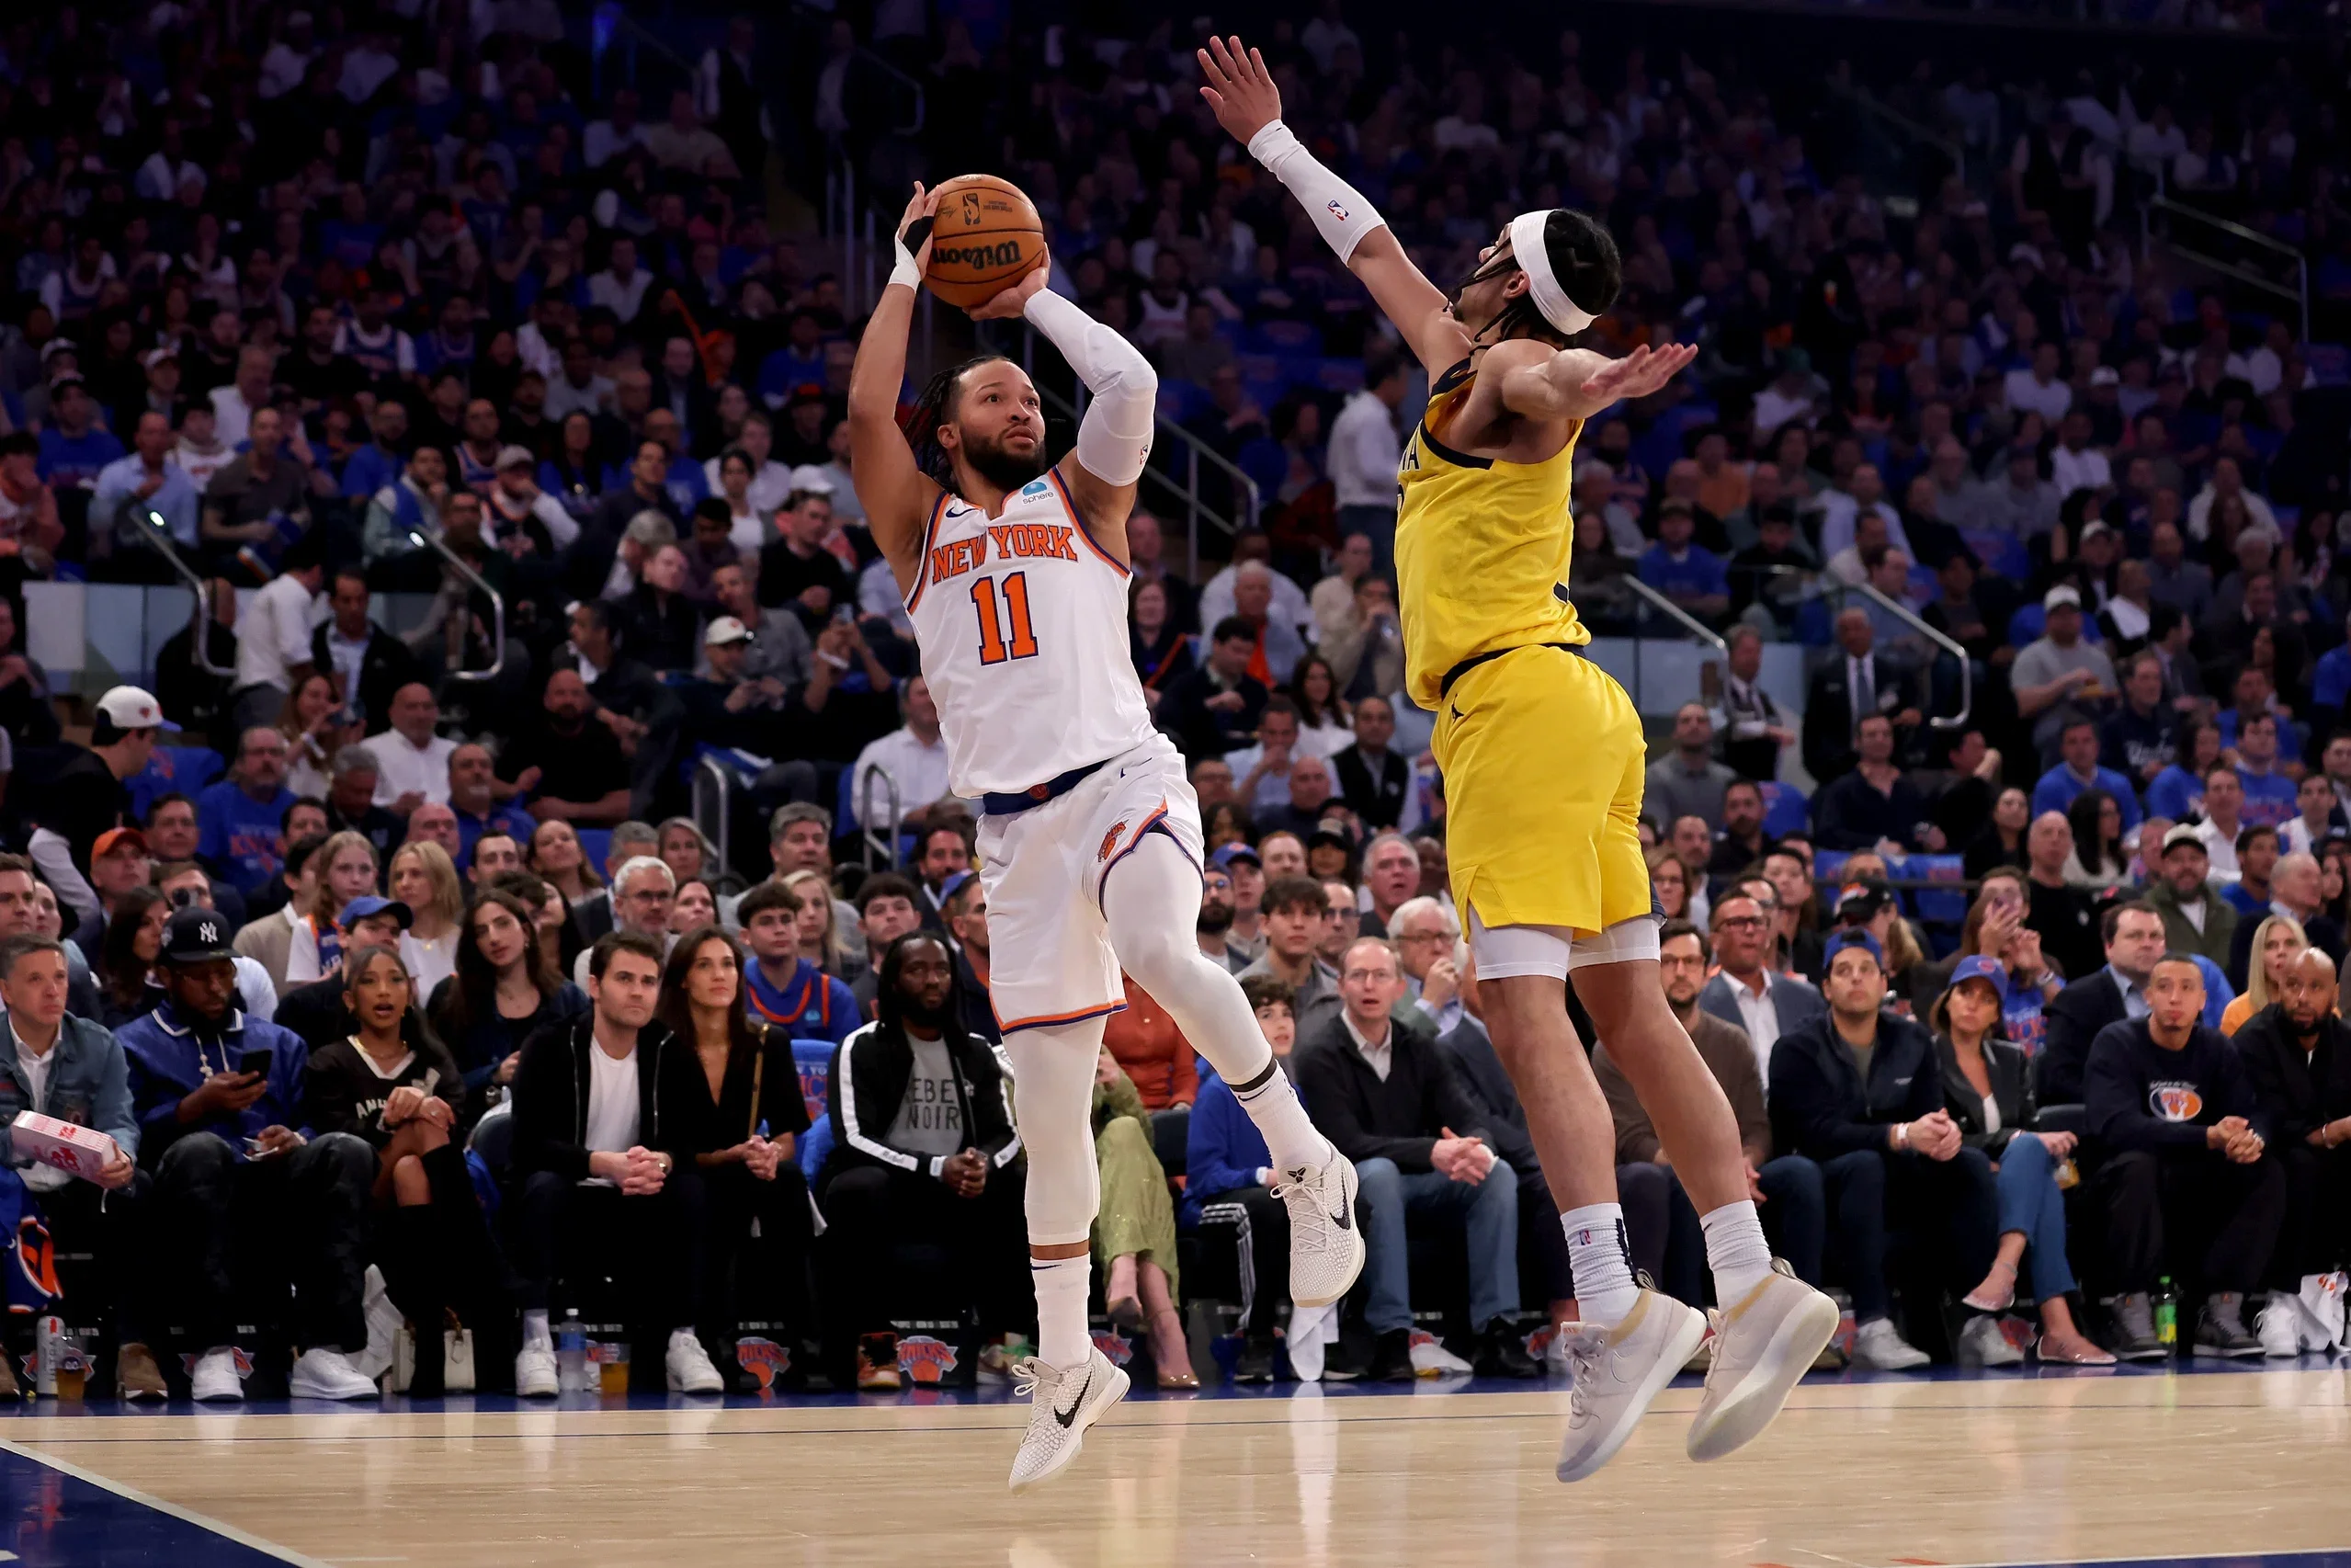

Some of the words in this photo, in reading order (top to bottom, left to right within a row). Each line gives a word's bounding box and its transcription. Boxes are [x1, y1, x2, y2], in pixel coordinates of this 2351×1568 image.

[932, 241, 1022, 270] Wilson
[1022, 491, 1054, 505] sphere
[932, 531, 988, 586] NEW
[988, 524, 1078, 562] YORK
[970, 571, 1039, 666] 11
[906, 1077, 956, 1103] EBE
[905, 1105, 960, 1130] NOIR
